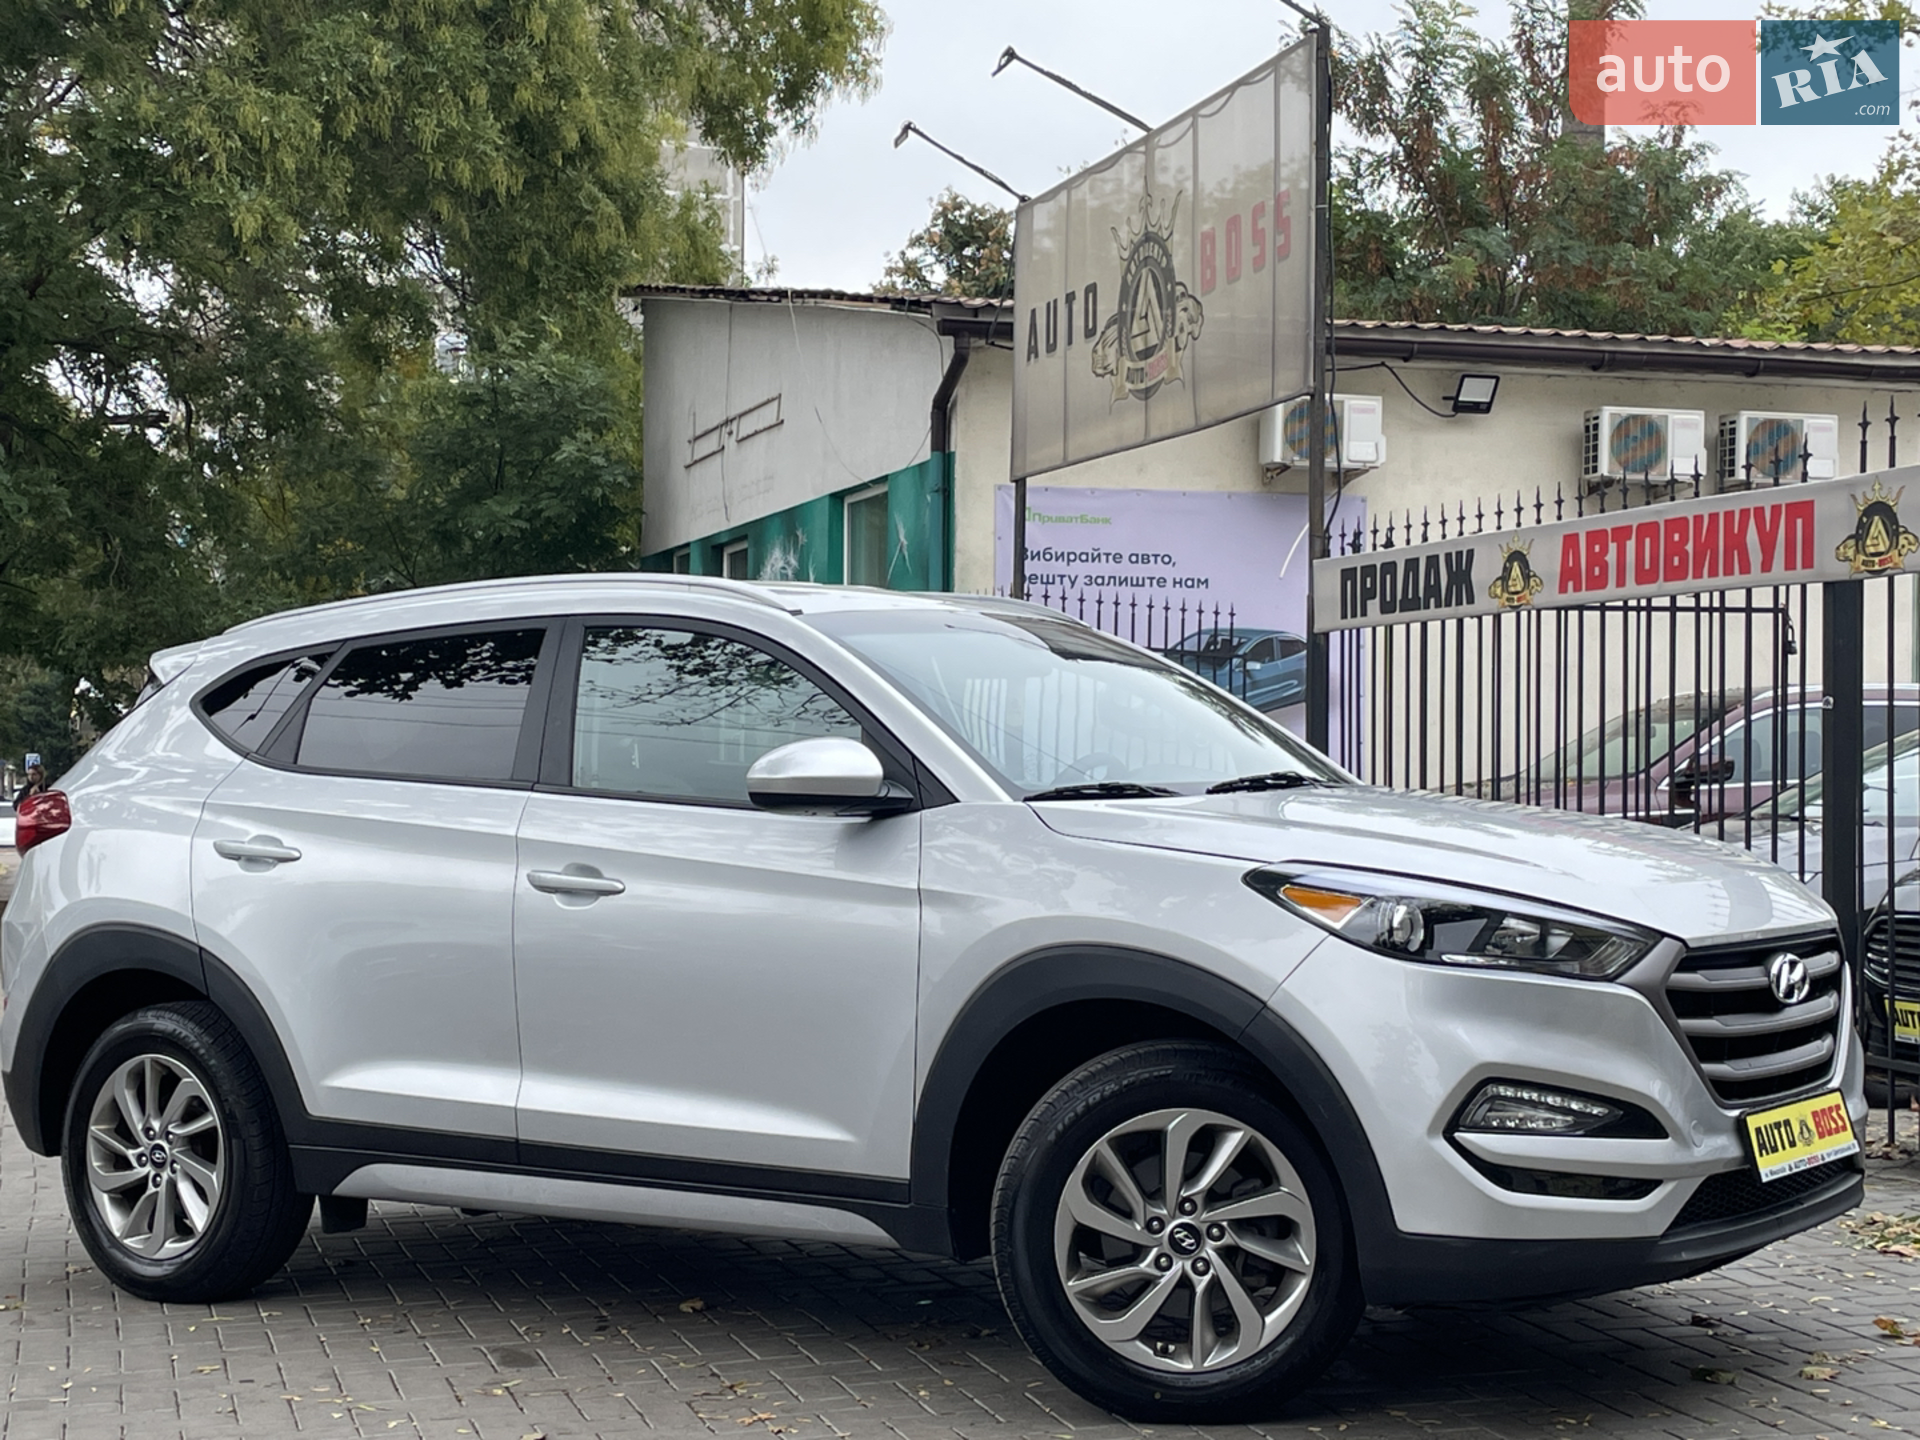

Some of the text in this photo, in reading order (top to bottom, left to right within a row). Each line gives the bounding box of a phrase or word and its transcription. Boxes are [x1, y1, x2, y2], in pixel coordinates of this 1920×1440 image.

[1026, 189, 1292, 363] AUTO BOSS
[1032, 511, 1112, 525] ПриватБанк
[1128, 551, 1176, 568] авто,
[1340, 499, 1815, 620] ПРОДАЖ АВТОВИКУП
[1083, 574, 1167, 589] залиште
[1172, 575, 1209, 589] нам
[1894, 1007, 1920, 1029] AUT
[1754, 1118, 1797, 1158] AUTO
[1811, 1103, 1848, 1140] BOSS
